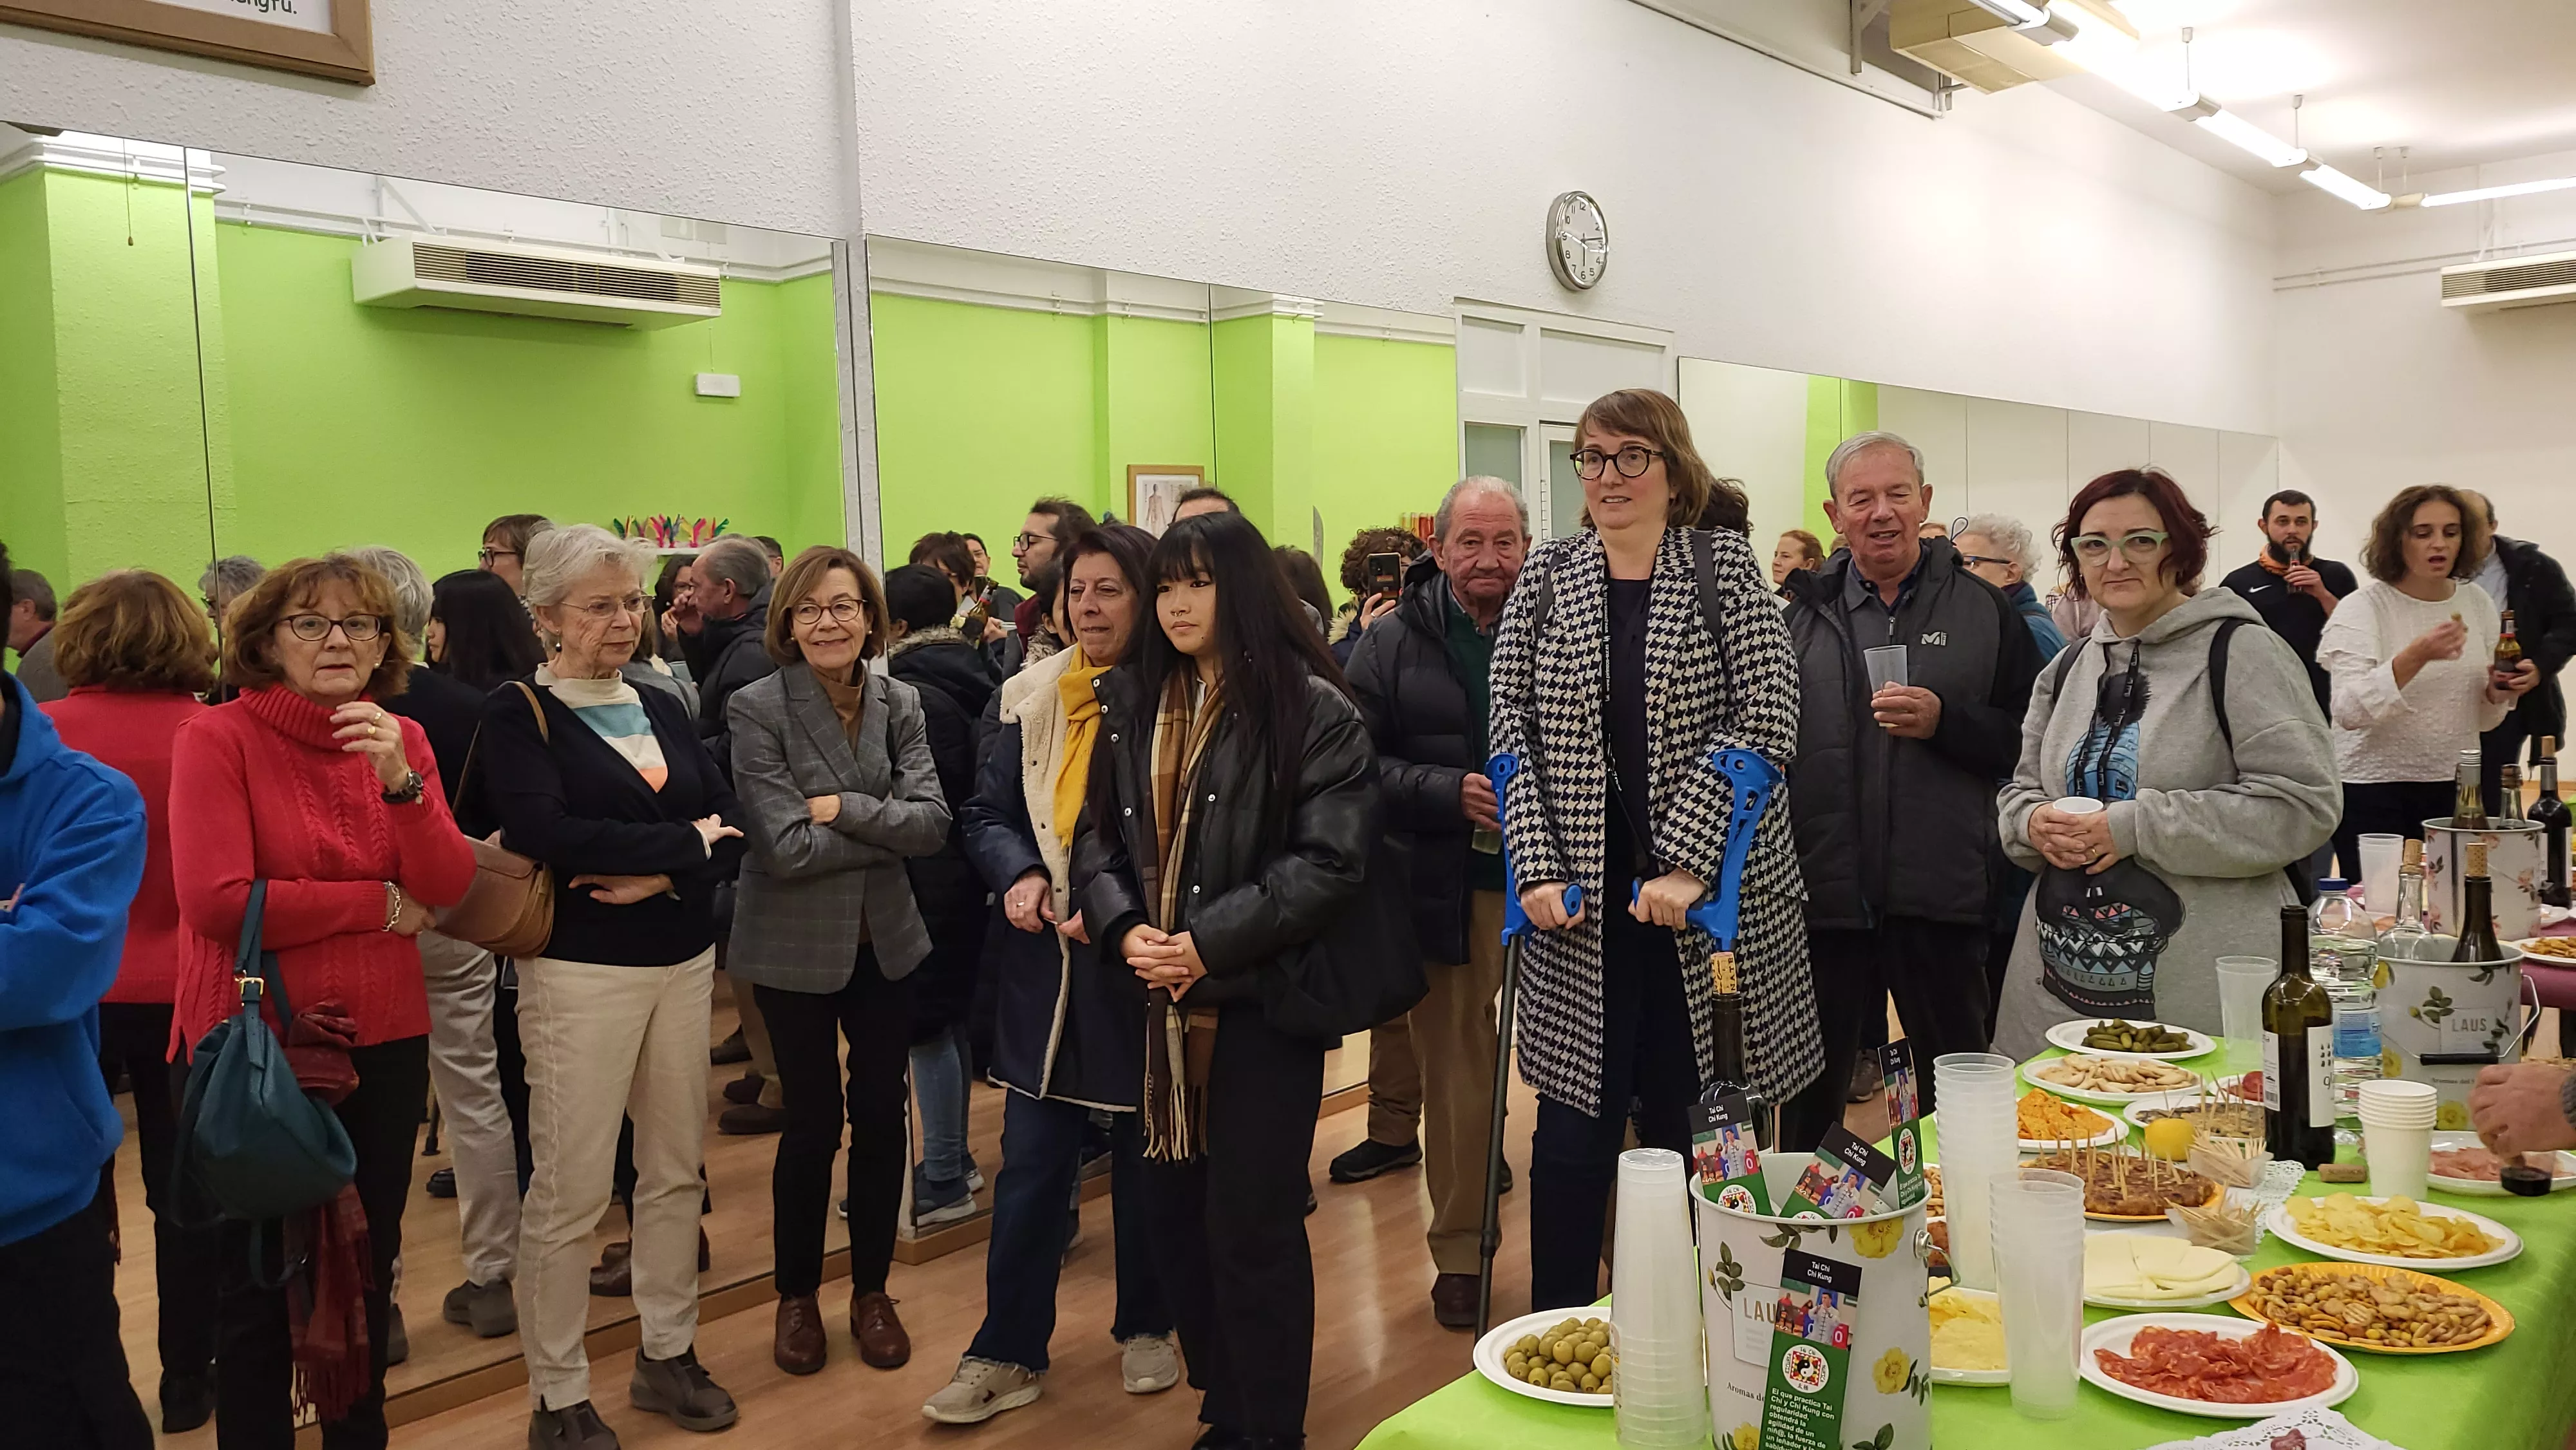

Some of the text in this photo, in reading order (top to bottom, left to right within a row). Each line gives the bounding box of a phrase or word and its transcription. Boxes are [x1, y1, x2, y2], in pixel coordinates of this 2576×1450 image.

[1571, 205, 1576, 214] 11
[1579, 202, 1586, 211] 12
[1565, 216, 1570, 224] 10
[1565, 250, 1571, 259] 8
[1571, 264, 1577, 273] 7
[1589, 268, 1595, 276] 5
[1580, 271, 1586, 279] 6
[2451, 1018, 2486, 1031] LAUS
[1716, 1113, 1728, 1122] Kung
[1859, 1147, 1869, 1156] Chi
[1844, 1148, 1866, 1167] Chi Kung
[1812, 1261, 1830, 1272] Tai Chi
[1807, 1269, 1832, 1283] Chi Kung
[1744, 1297, 1776, 1324] LAU
[1727, 1382, 1754, 1399] Aromas
[1771, 1395, 1782, 1404] Chi
[1790, 1401, 1801, 1409] Chi
[1803, 1405, 1821, 1417] Kung
[1821, 1411, 1835, 1420] con
[1794, 1396, 1821, 1407] practica
[1823, 1402, 1832, 1411] Tai
[1769, 1411, 1799, 1424] obtendrá
[1770, 1404, 1810, 1421] regularidad,
[1768, 1419, 1794, 1431] agilidad
[1776, 1436, 1801, 1449] leñador
[1795, 1435, 1815, 1446] fuerza
